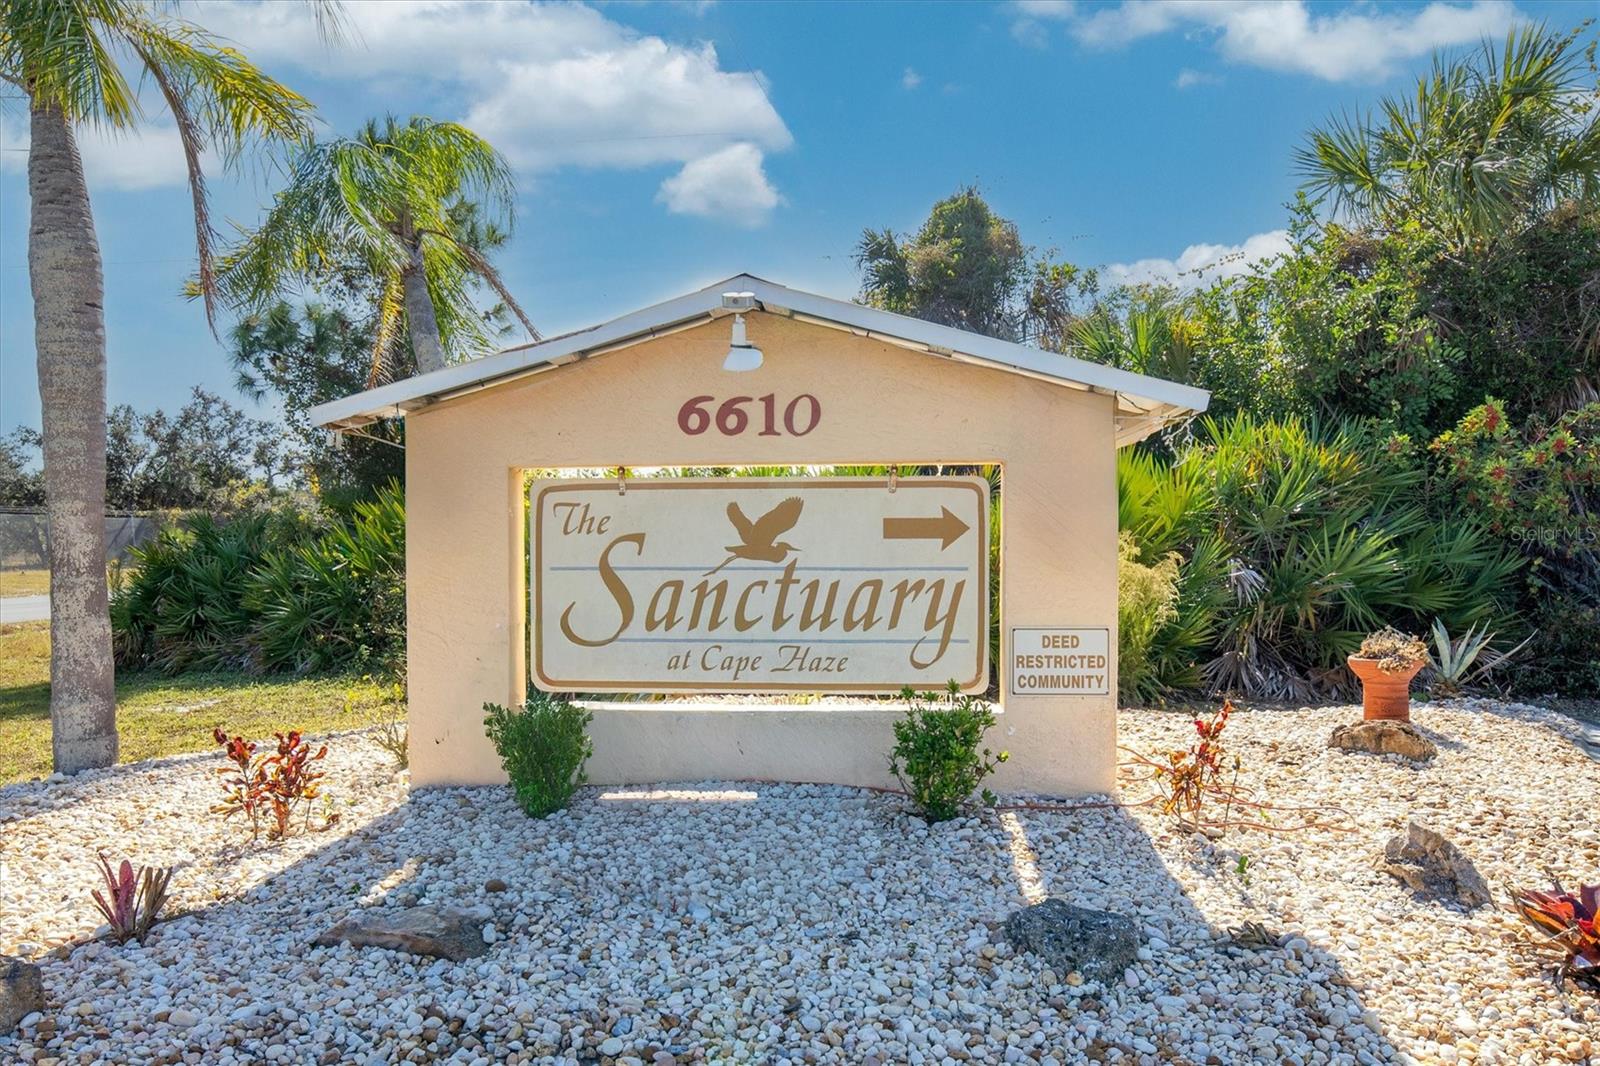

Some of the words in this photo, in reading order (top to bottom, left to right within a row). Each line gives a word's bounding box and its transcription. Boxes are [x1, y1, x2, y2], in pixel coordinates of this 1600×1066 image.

[677, 393, 821, 437] 6610
[553, 502, 611, 535] The
[560, 532, 967, 670] Sanctuary
[1041, 634, 1080, 649] DEED
[667, 650, 691, 671] at
[700, 644, 762, 680] Cape
[769, 645, 849, 672] Haze
[1015, 654, 1106, 669] RESTRICTED
[1017, 674, 1105, 689] COMMUNITY
